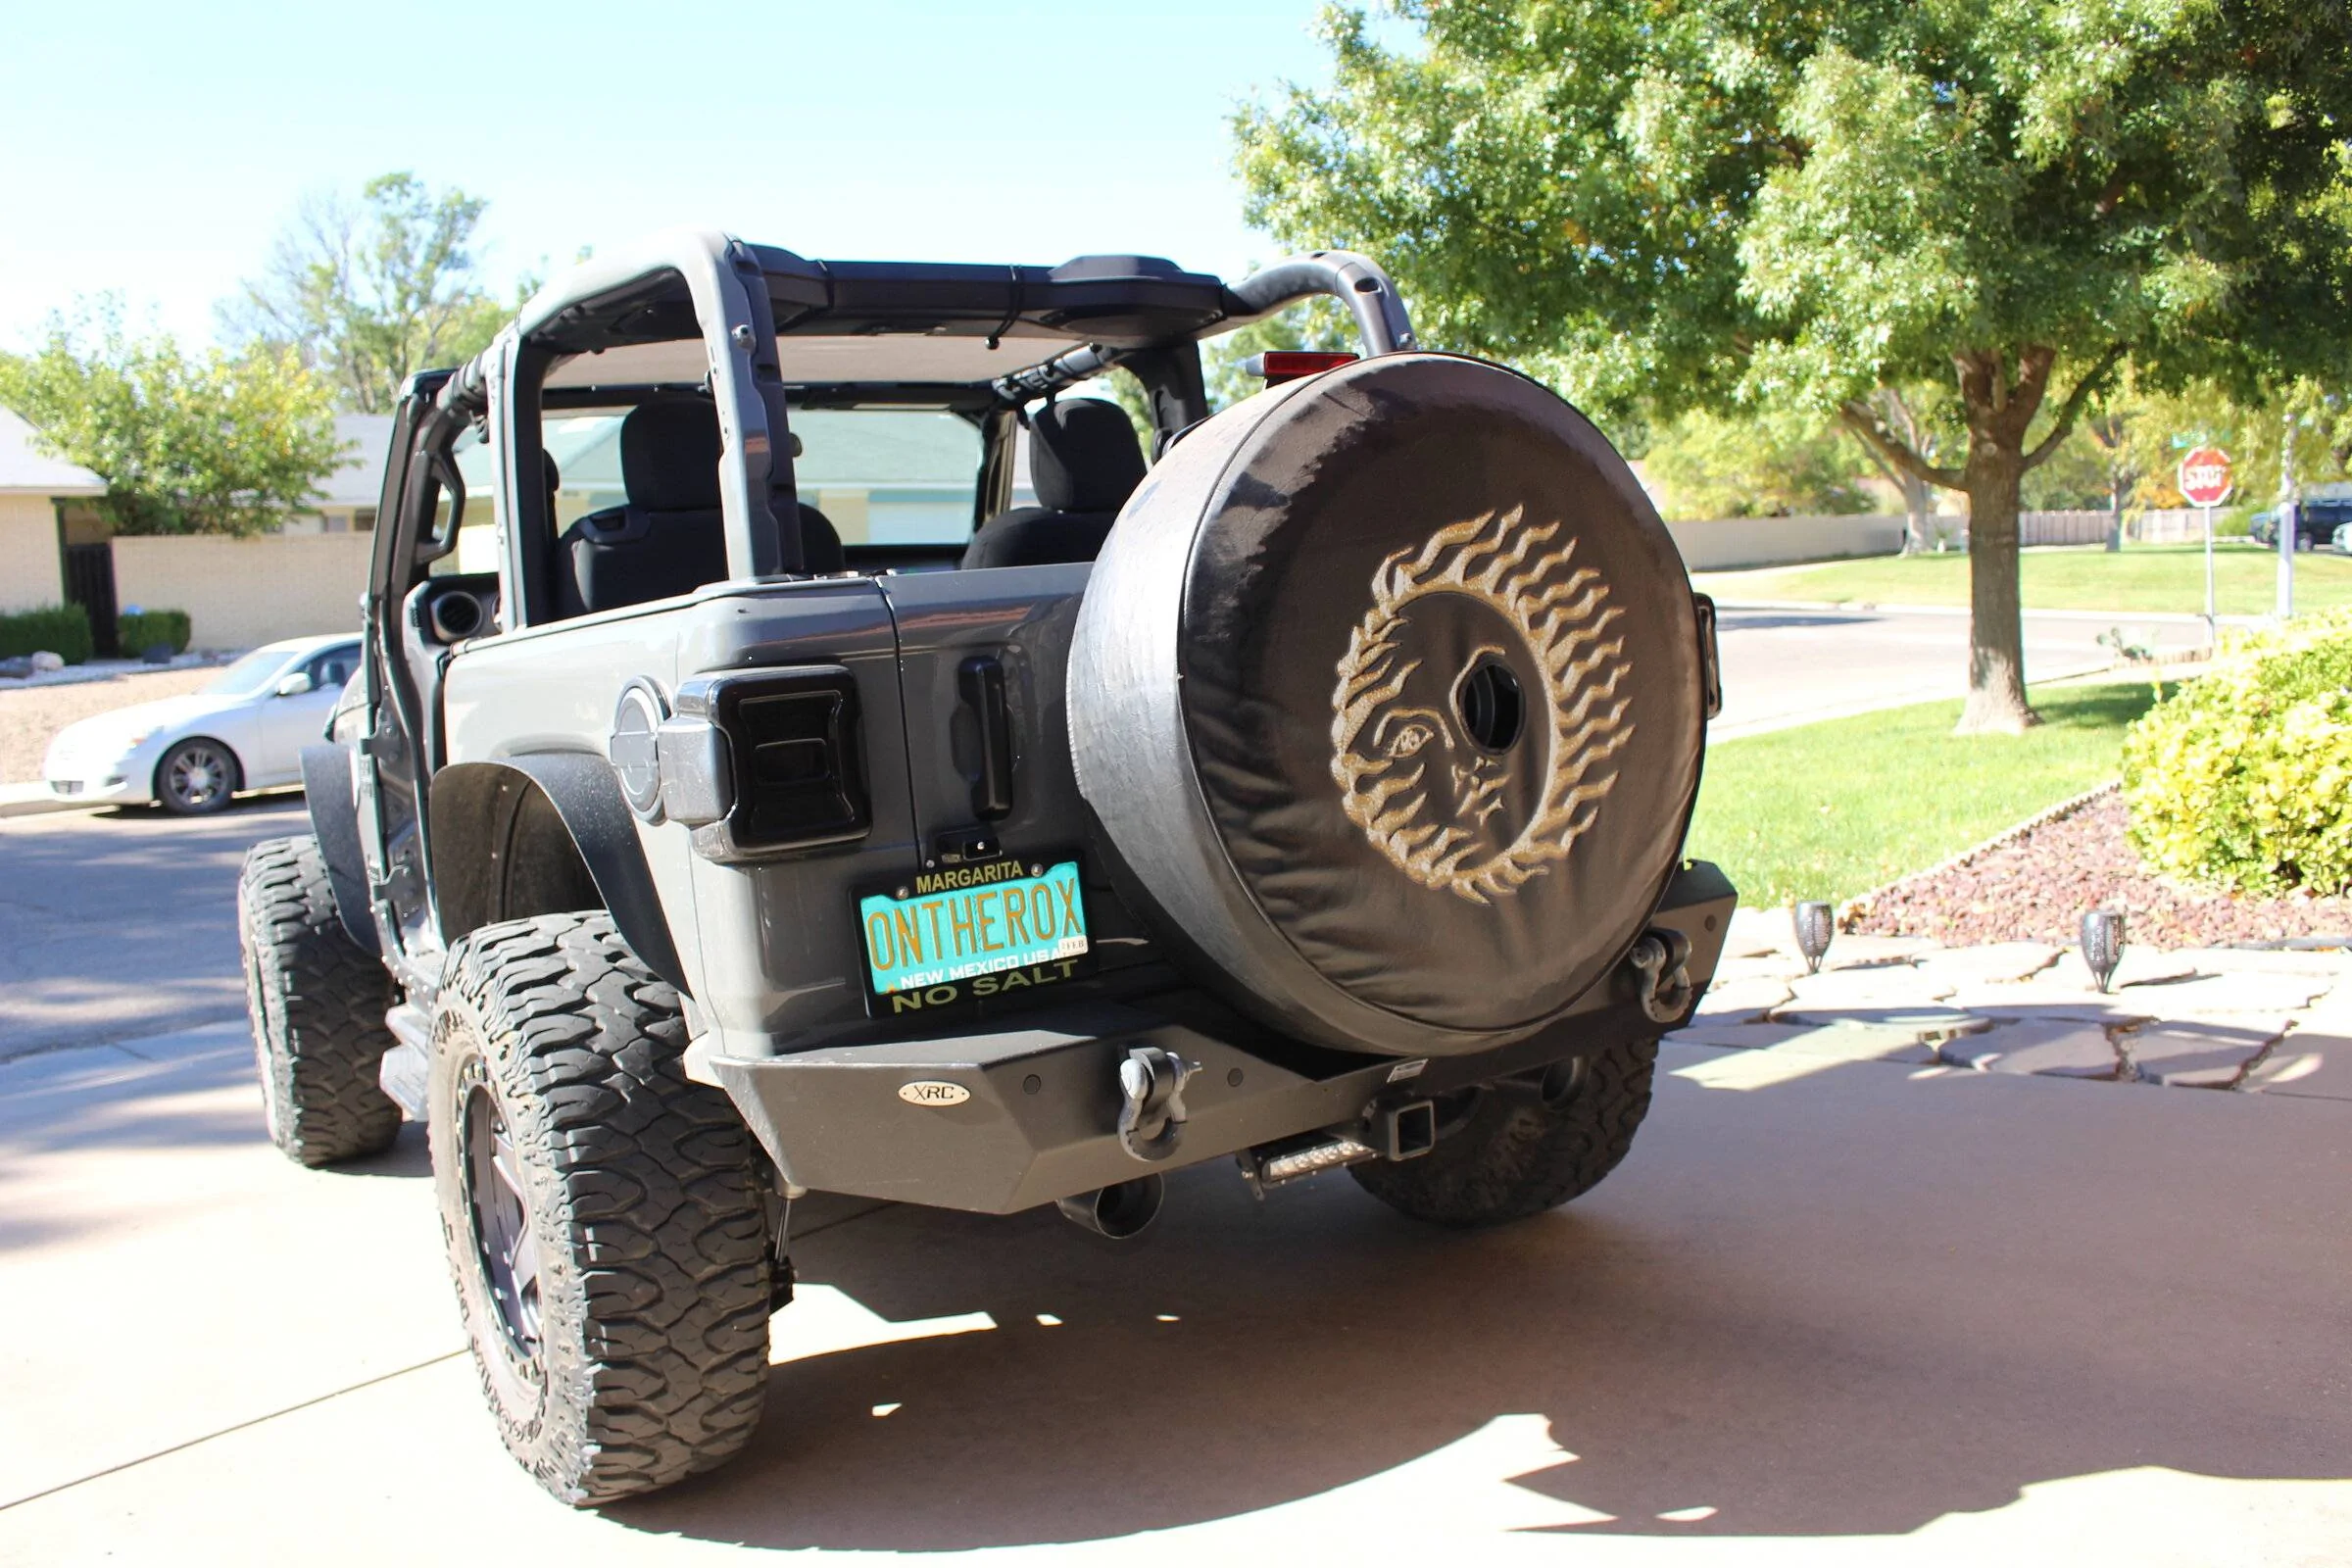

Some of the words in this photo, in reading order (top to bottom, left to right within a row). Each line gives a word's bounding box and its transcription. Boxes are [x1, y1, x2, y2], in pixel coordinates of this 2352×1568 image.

[2184, 466, 2227, 490] STOP
[916, 860, 1023, 894] MARGARITA
[866, 878, 1082, 971] ONTHEROX
[892, 986, 957, 1013] NO
[972, 959, 1078, 996] SALT
[900, 968, 944, 990] NEW
[949, 956, 1019, 982] MEXICO
[913, 1085, 955, 1101] XRC
